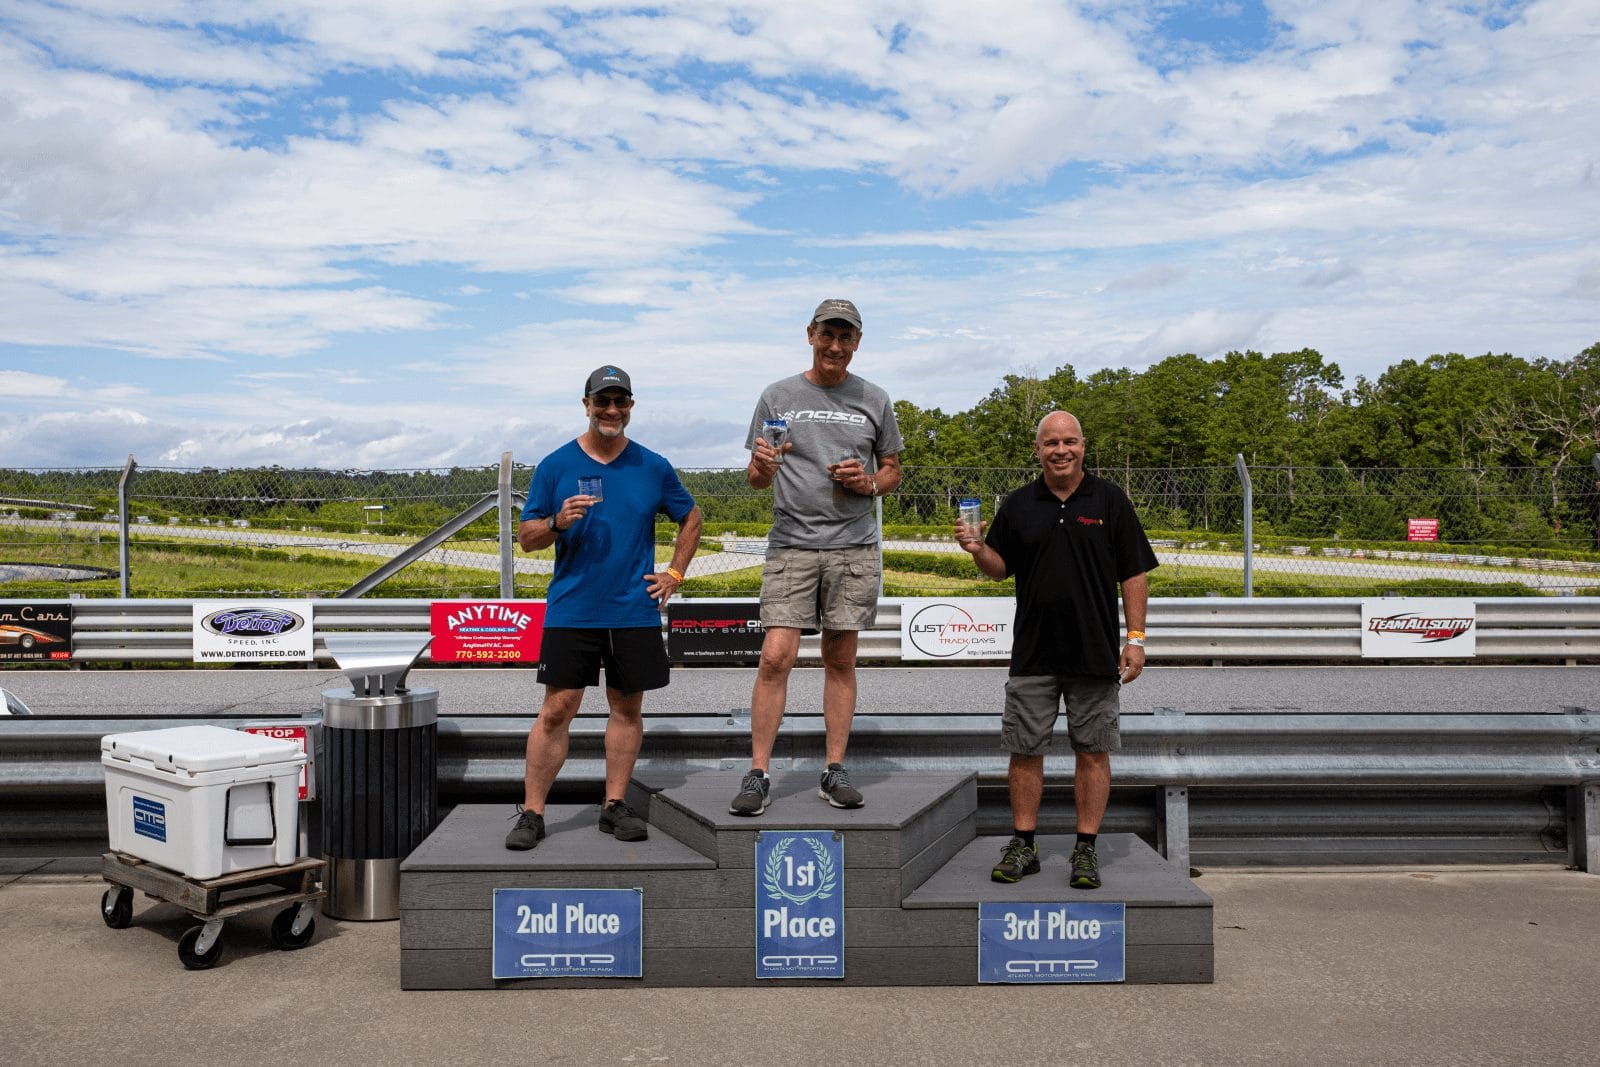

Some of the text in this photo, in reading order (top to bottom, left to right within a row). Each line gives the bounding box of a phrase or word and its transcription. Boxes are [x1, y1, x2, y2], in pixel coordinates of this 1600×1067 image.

[20, 606, 69, 621] Cars
[214, 612, 293, 634] Detroit
[447, 604, 532, 630] ANYTIME
[912, 624, 945, 633] JUST
[200, 650, 306, 658] WWW.DETROITSPEED.COM
[455, 650, 521, 659] 770-592-2200
[256, 729, 294, 738] STOP
[784, 856, 815, 887] 1st
[516, 902, 621, 935] 2nd Place
[764, 906, 836, 938] Place
[1003, 908, 1102, 941] 3rd Place
